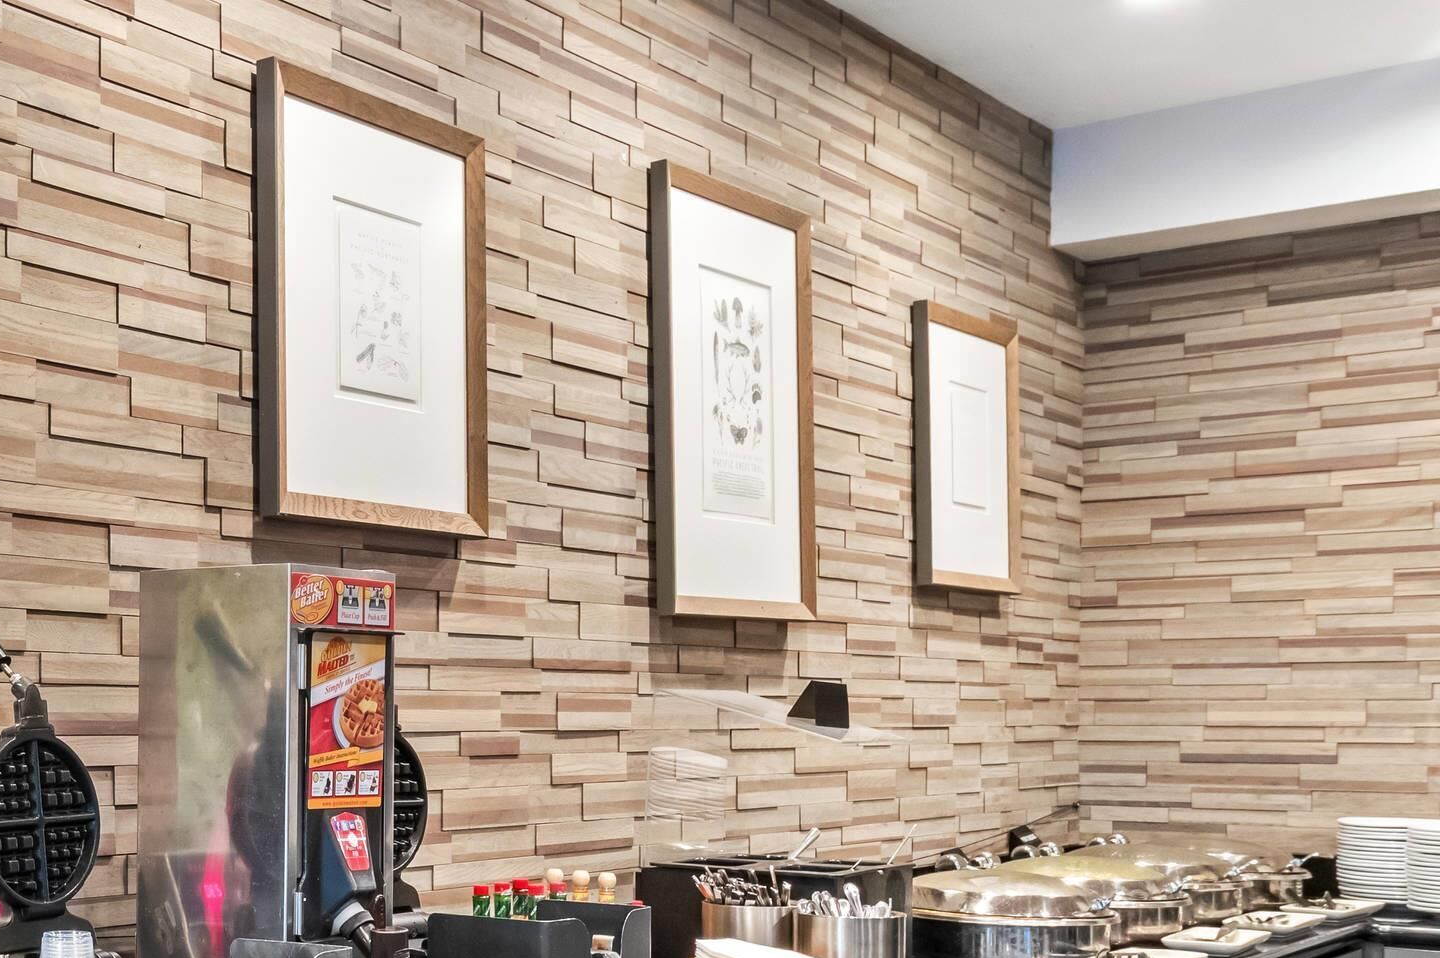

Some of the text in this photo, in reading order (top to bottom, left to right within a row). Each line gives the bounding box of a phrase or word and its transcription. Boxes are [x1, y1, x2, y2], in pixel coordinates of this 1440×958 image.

[294, 581, 324, 599] Better
[300, 589, 328, 609] Batter
[318, 655, 349, 676] MALTED
[324, 680, 344, 695] Simply
[345, 677, 354, 687] the
